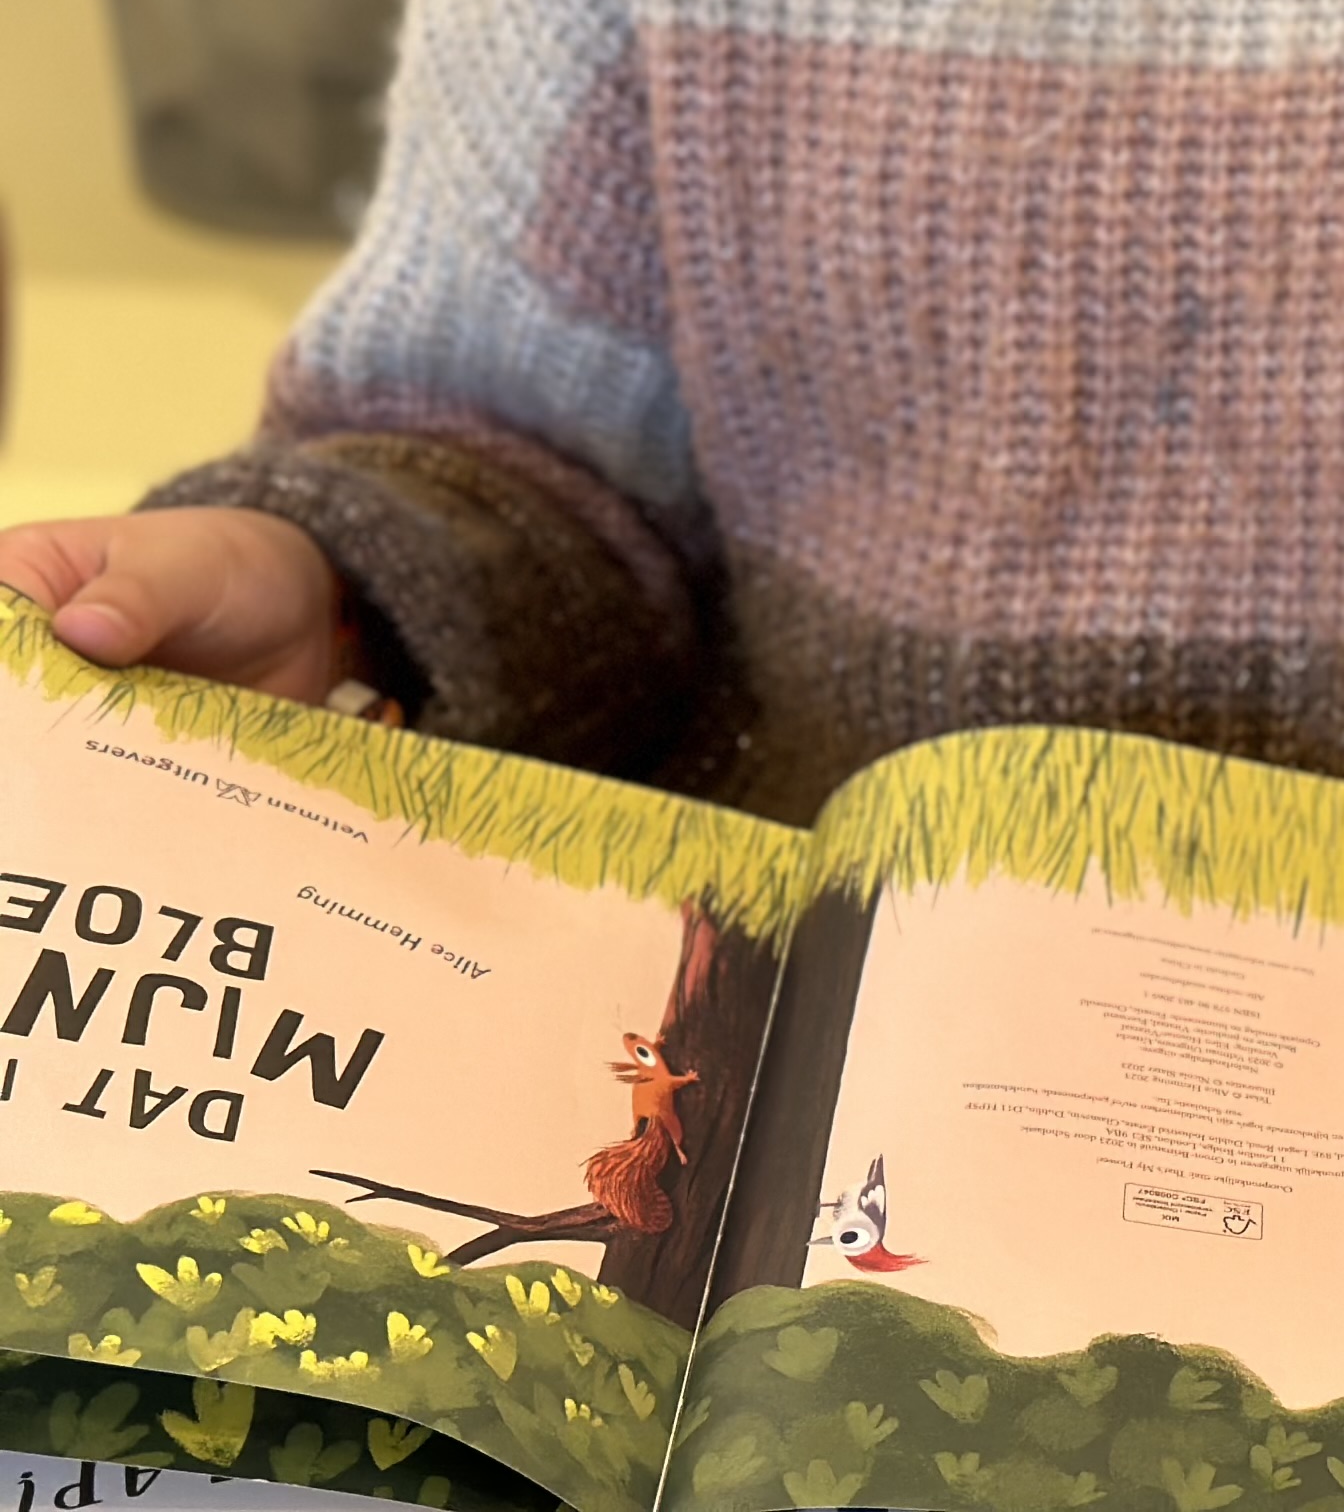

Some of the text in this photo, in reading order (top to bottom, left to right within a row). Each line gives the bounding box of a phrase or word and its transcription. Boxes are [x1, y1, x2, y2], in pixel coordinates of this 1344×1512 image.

[85, 739, 368, 844] Veltman Uitgevers
[297, 886, 490, 980] Alice Hemming
[1, 949, 385, 1110] MIJN
[61, 1069, 244, 1142] DAT
